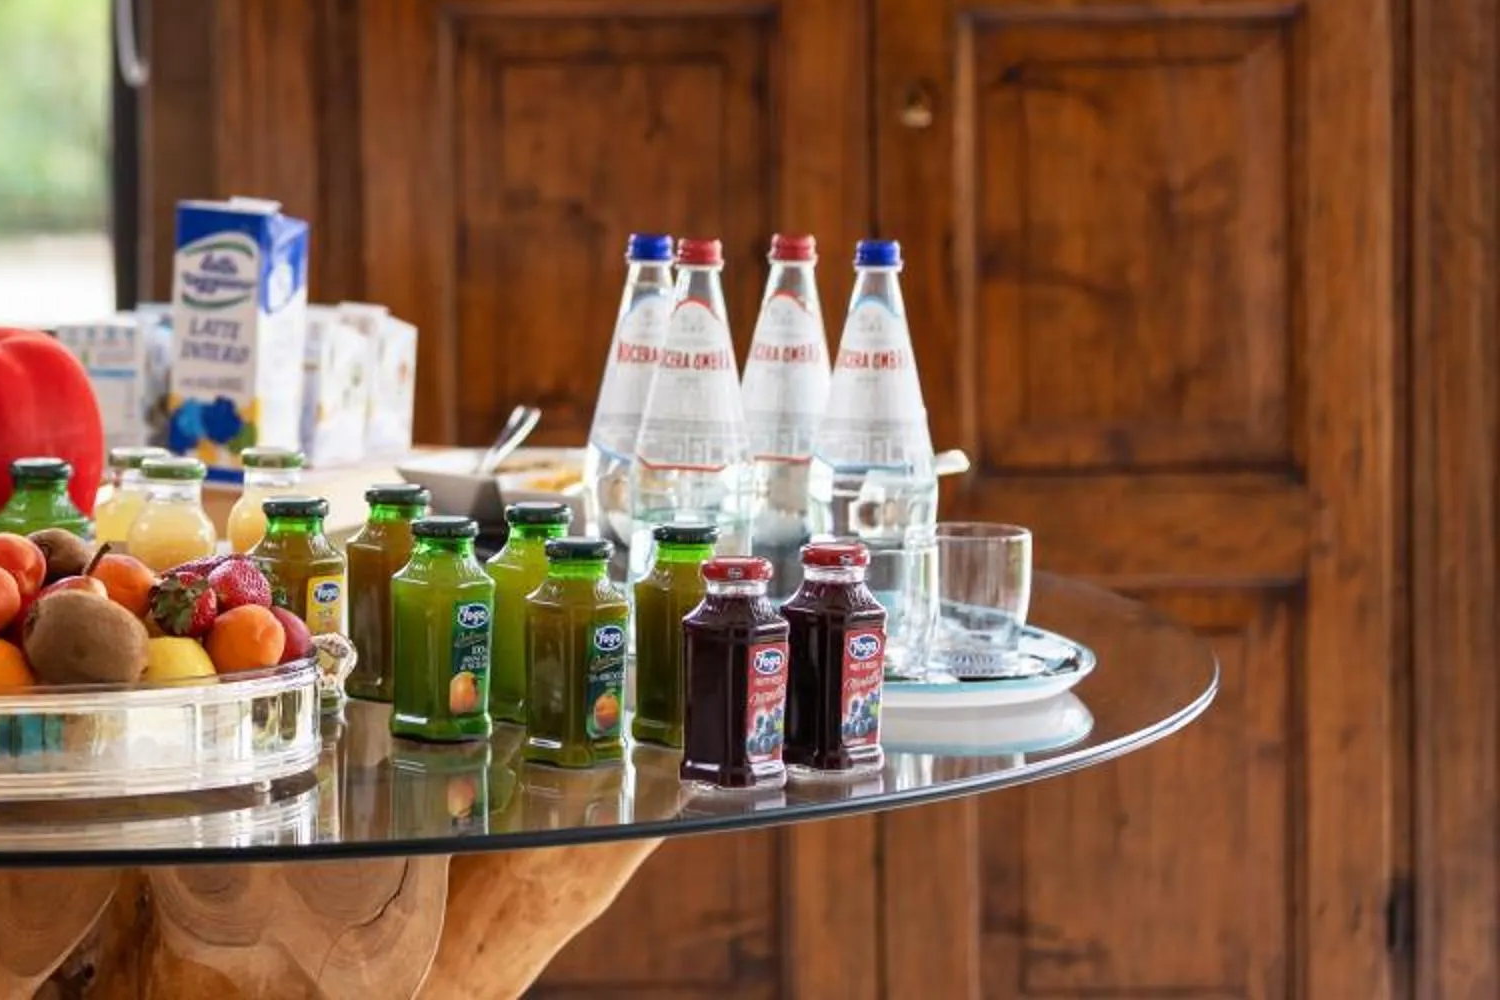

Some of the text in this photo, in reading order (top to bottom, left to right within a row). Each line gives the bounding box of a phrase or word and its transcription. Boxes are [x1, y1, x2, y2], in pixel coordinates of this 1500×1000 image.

[459, 606, 487, 626] Yoga
[596, 628, 621, 648] Yoga
[850, 637, 878, 657] Yoga
[756, 652, 782, 672] Yoga
